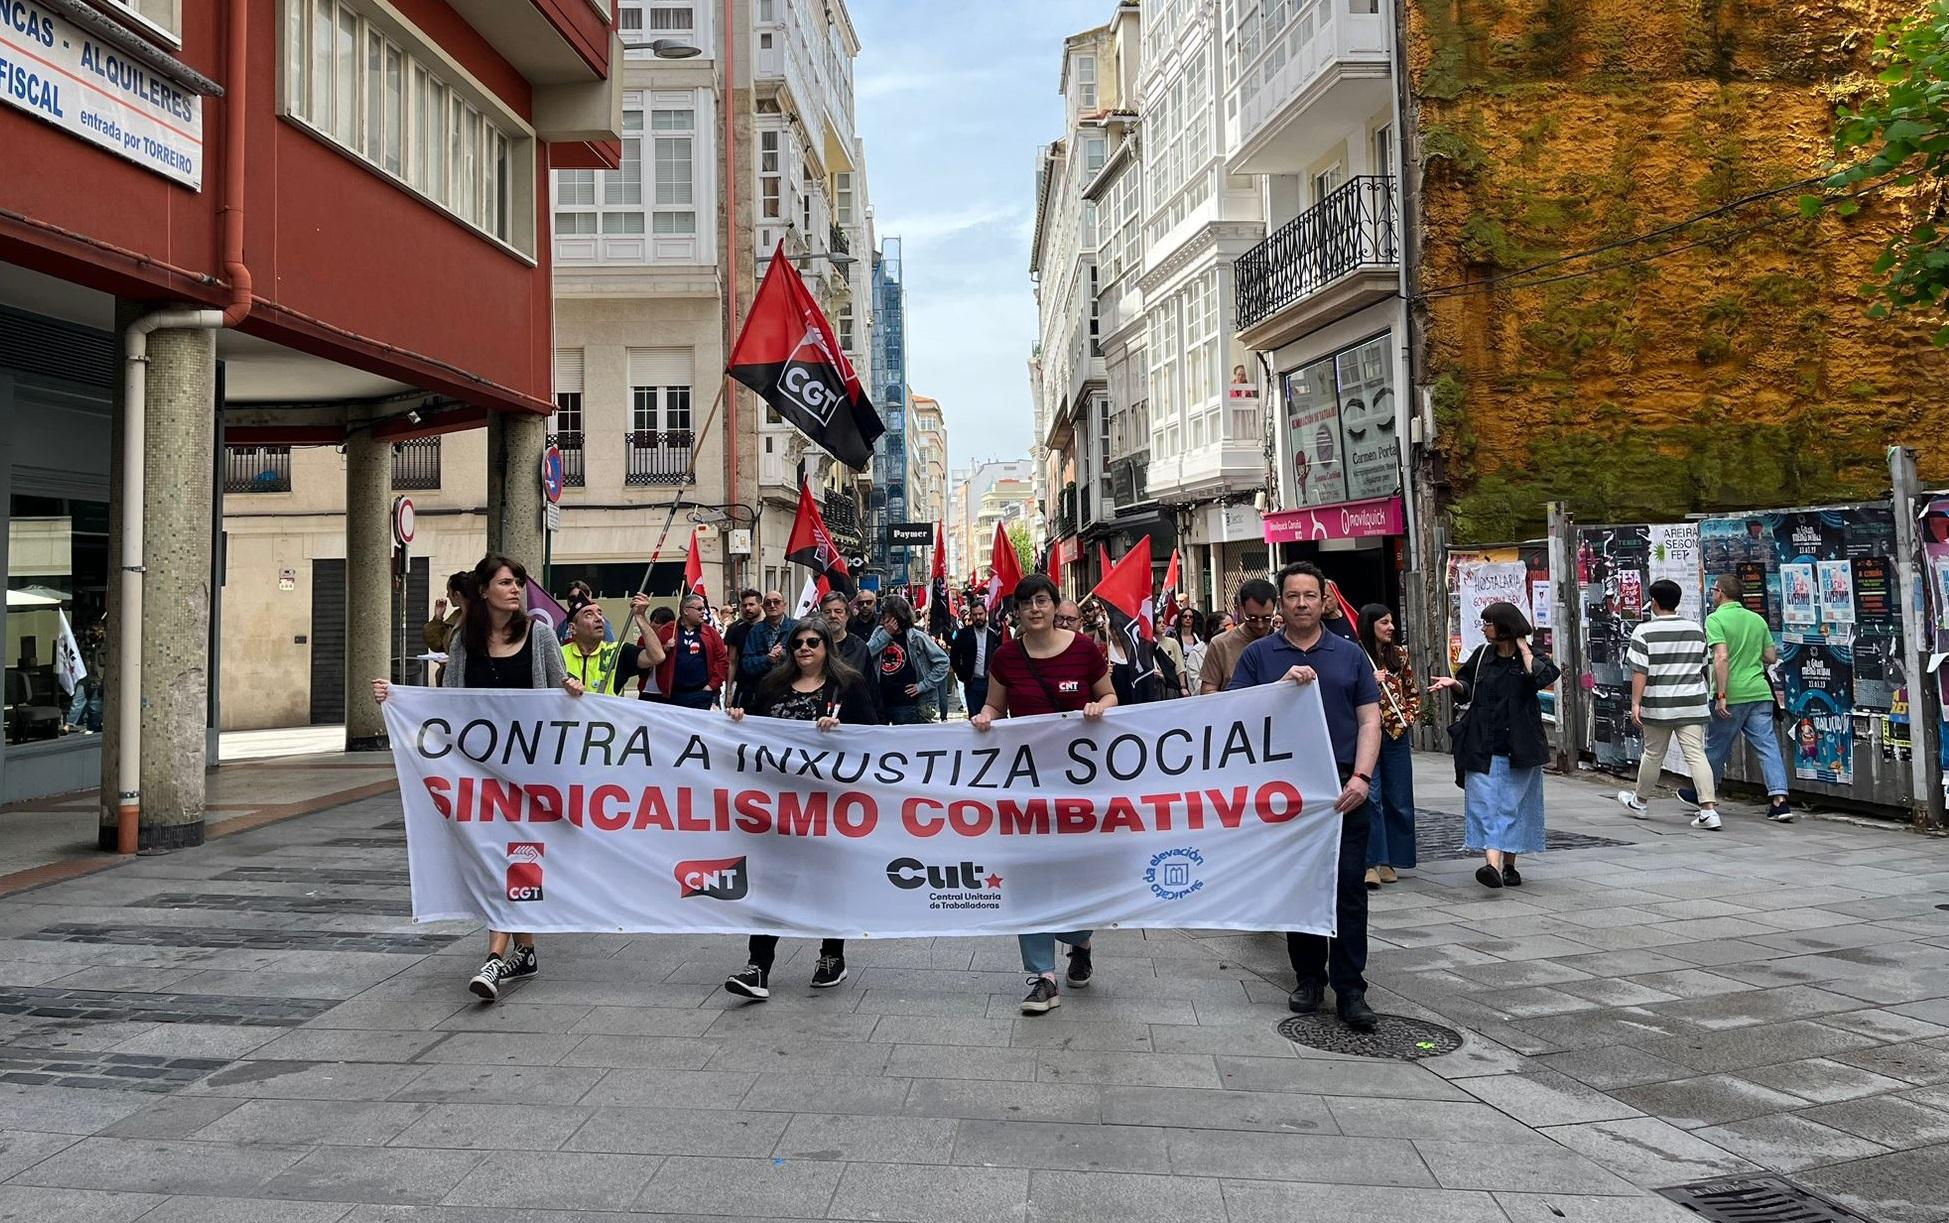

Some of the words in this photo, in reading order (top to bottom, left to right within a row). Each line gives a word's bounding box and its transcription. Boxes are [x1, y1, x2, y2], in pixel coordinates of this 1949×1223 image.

[81, 41, 192, 122] ALQUILERES
[80, 110, 121, 140] entrada
[124, 132, 141, 149] por
[143, 136, 192, 175] TORREIRO
[785, 367, 838, 415] CGT
[1352, 452, 1377, 465] Carmen
[1350, 508, 1386, 530] movilquick
[893, 529, 928, 539] Paymer
[1058, 681, 1078, 690] CNT
[417, 718, 652, 767] CONTRA
[674, 735, 711, 769] A
[737, 743, 1040, 788] INXUSTIZA
[1065, 716, 1293, 786] SOCIAL
[422, 776, 878, 838] SINDICALISMO
[901, 780, 1303, 837] COMBATIVO
[1142, 868, 1156, 883] da
[1150, 846, 1204, 867] elevación
[685, 868, 737, 891] CNT
[509, 886, 541, 900] CGT
[964, 893, 1001, 901] Unitaria
[941, 902, 1000, 910] Traballadoras
